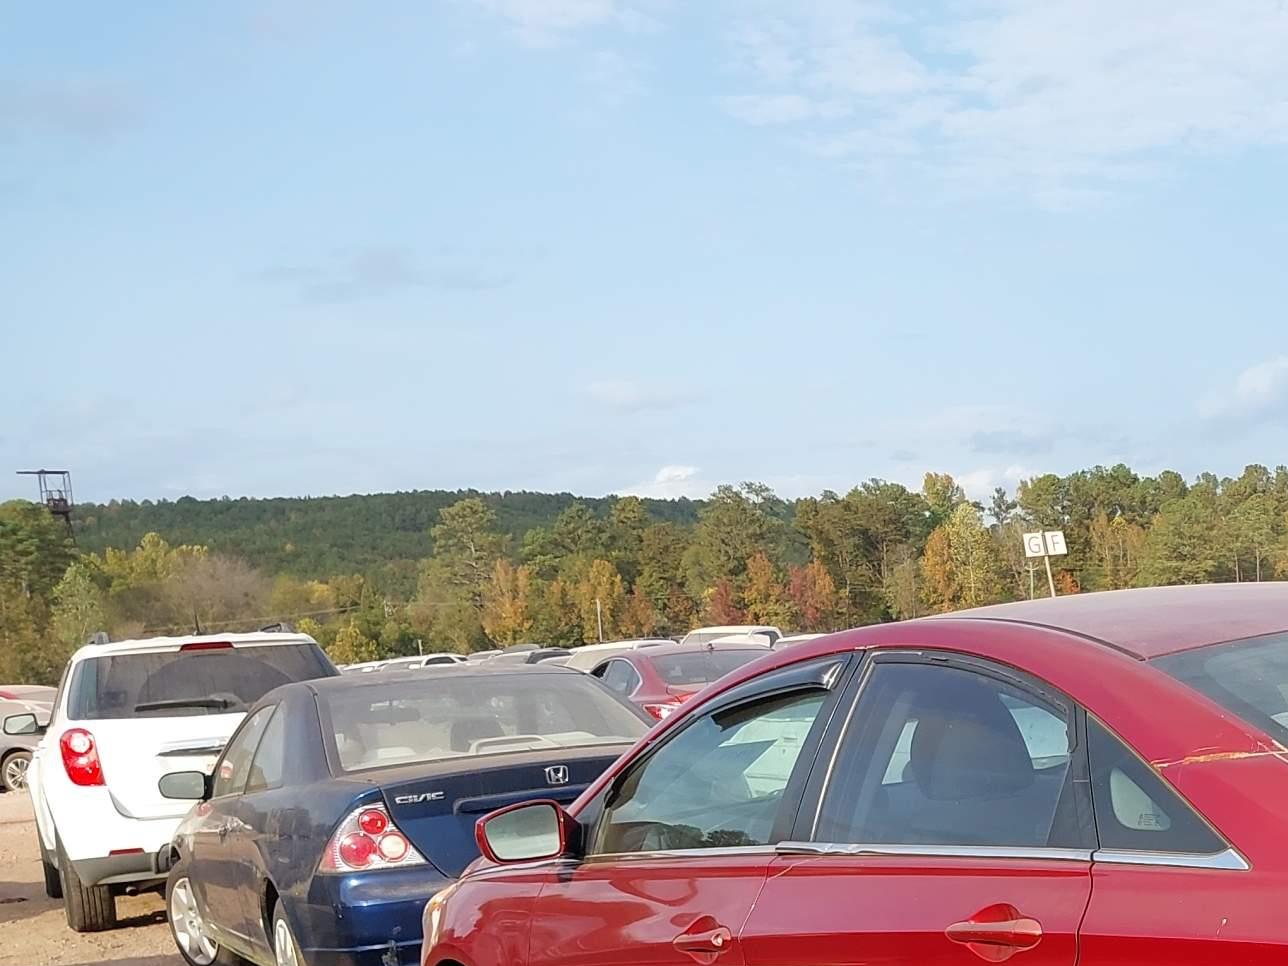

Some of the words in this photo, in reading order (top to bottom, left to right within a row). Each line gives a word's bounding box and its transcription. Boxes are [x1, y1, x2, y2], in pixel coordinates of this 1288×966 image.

[1028, 536, 1041, 554] G
[1051, 534, 1060, 552] F
[394, 791, 445, 804] CIVIC
